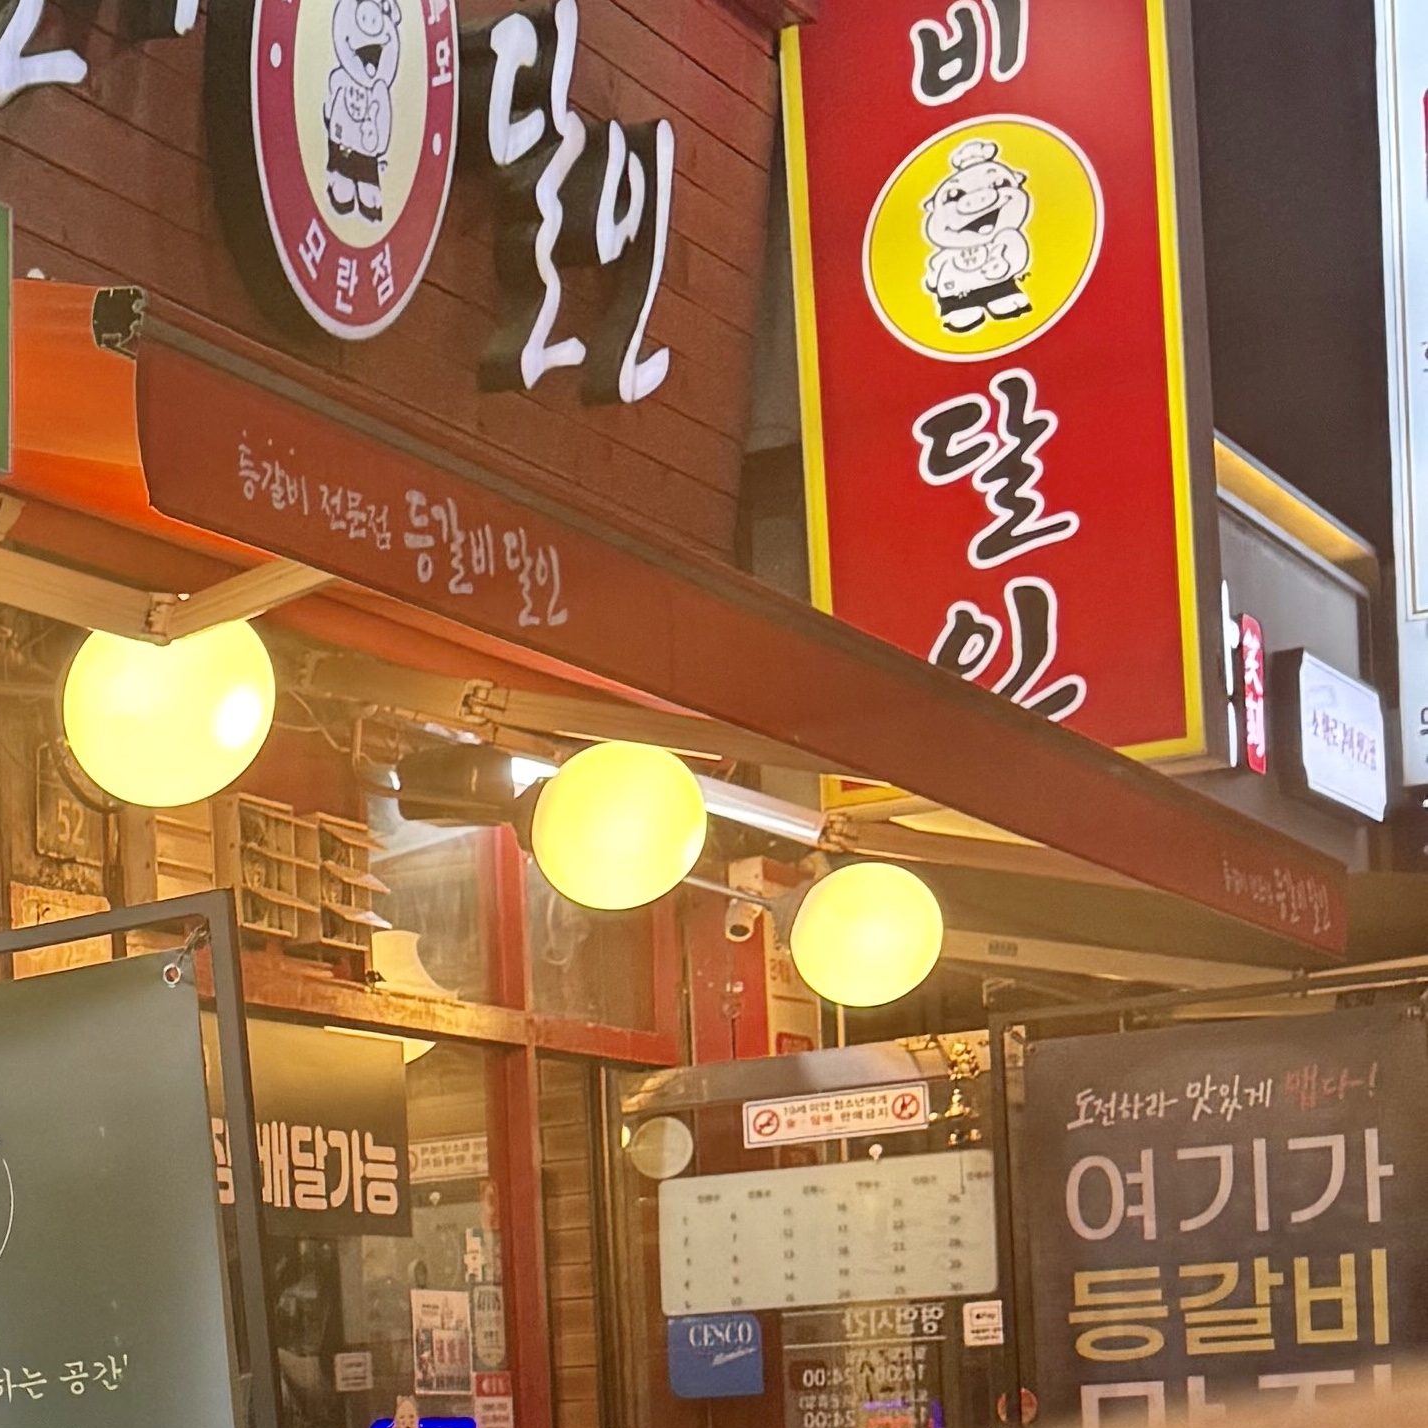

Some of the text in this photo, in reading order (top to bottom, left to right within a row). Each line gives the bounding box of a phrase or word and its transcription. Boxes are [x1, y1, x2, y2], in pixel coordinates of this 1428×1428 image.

[299, 217, 394, 315] 모란점
[319, 484, 391, 550] 전문점
[403, 490, 494, 595] 등갈비
[503, 527, 569, 627] 달인
[1067, 1088, 1179, 1131] 도전하라
[1186, 1074, 1273, 1122] 맛있게
[256, 1120, 398, 1215] 배달가능
[1065, 1128, 1394, 1240] 여기가
[1068, 1248, 1390, 1362] 등갈비
